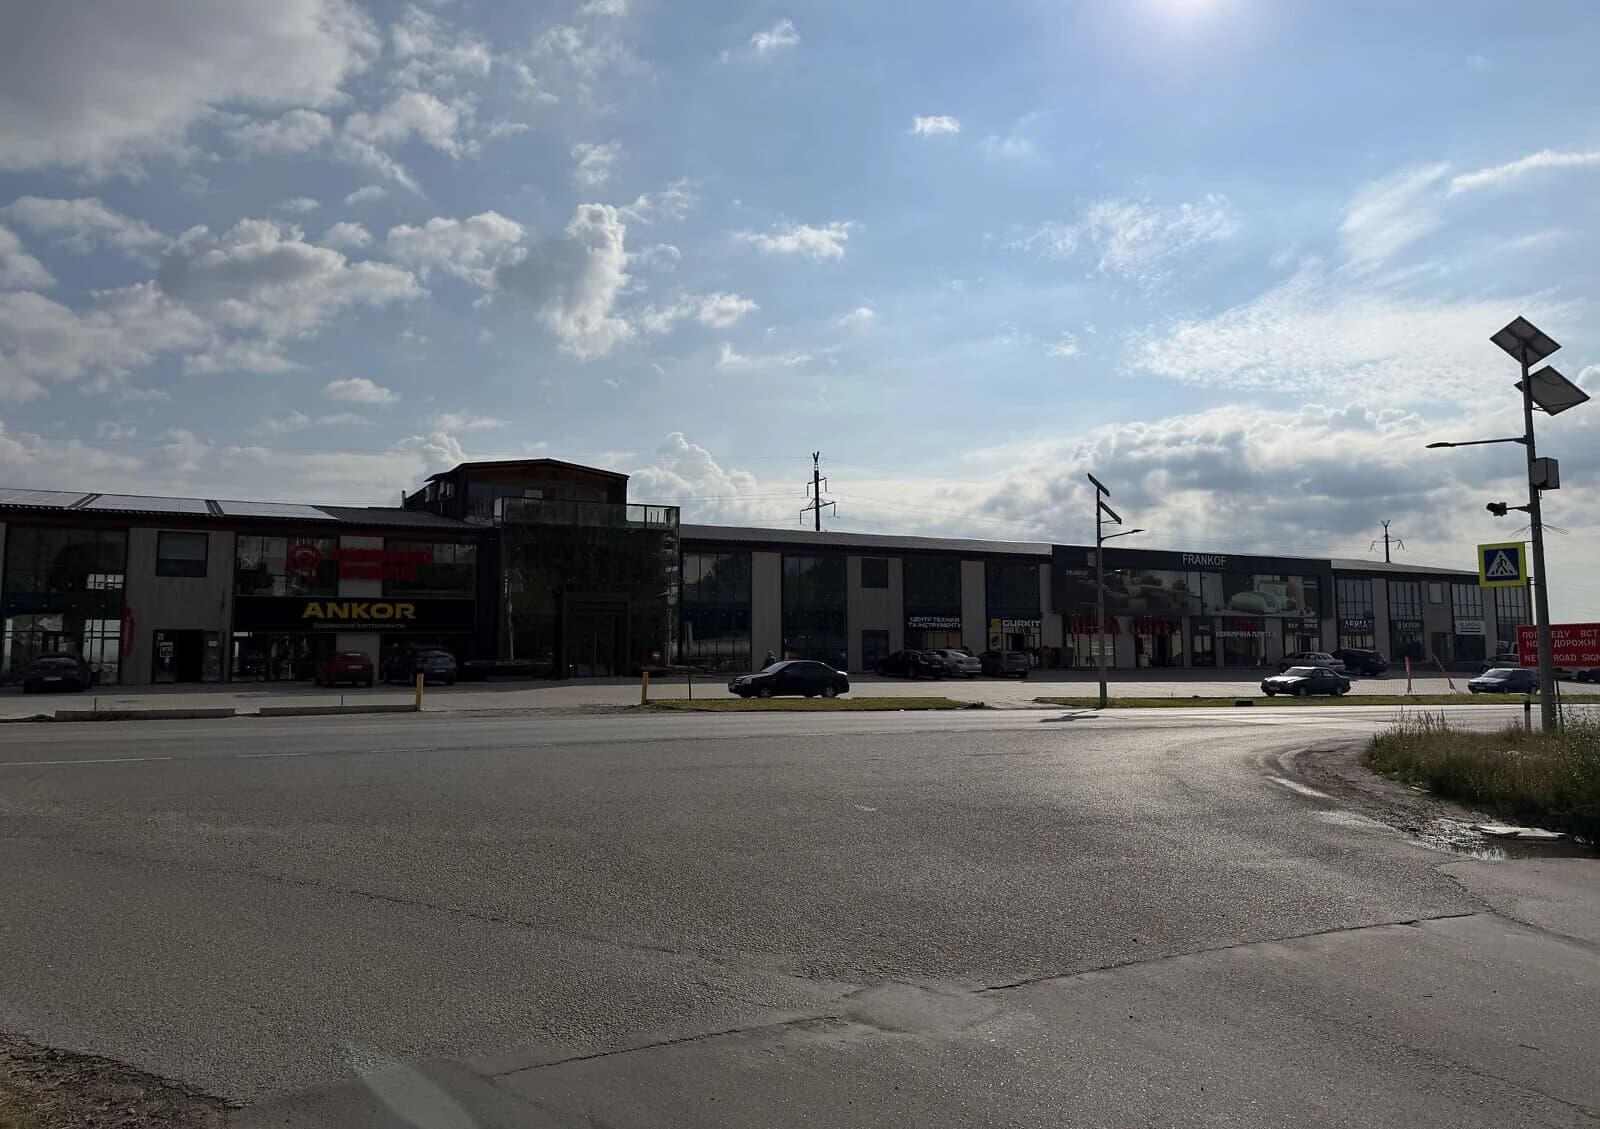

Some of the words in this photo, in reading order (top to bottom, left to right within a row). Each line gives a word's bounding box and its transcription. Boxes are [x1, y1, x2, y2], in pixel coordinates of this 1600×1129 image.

[1182, 554, 1226, 567] FRANKOF
[302, 602, 416, 619] ANKOR
[1002, 619, 1041, 628] GURKIT
[1554, 639, 1596, 648] ДОРОЖНІ
[1553, 653, 1577, 662] ROAD
